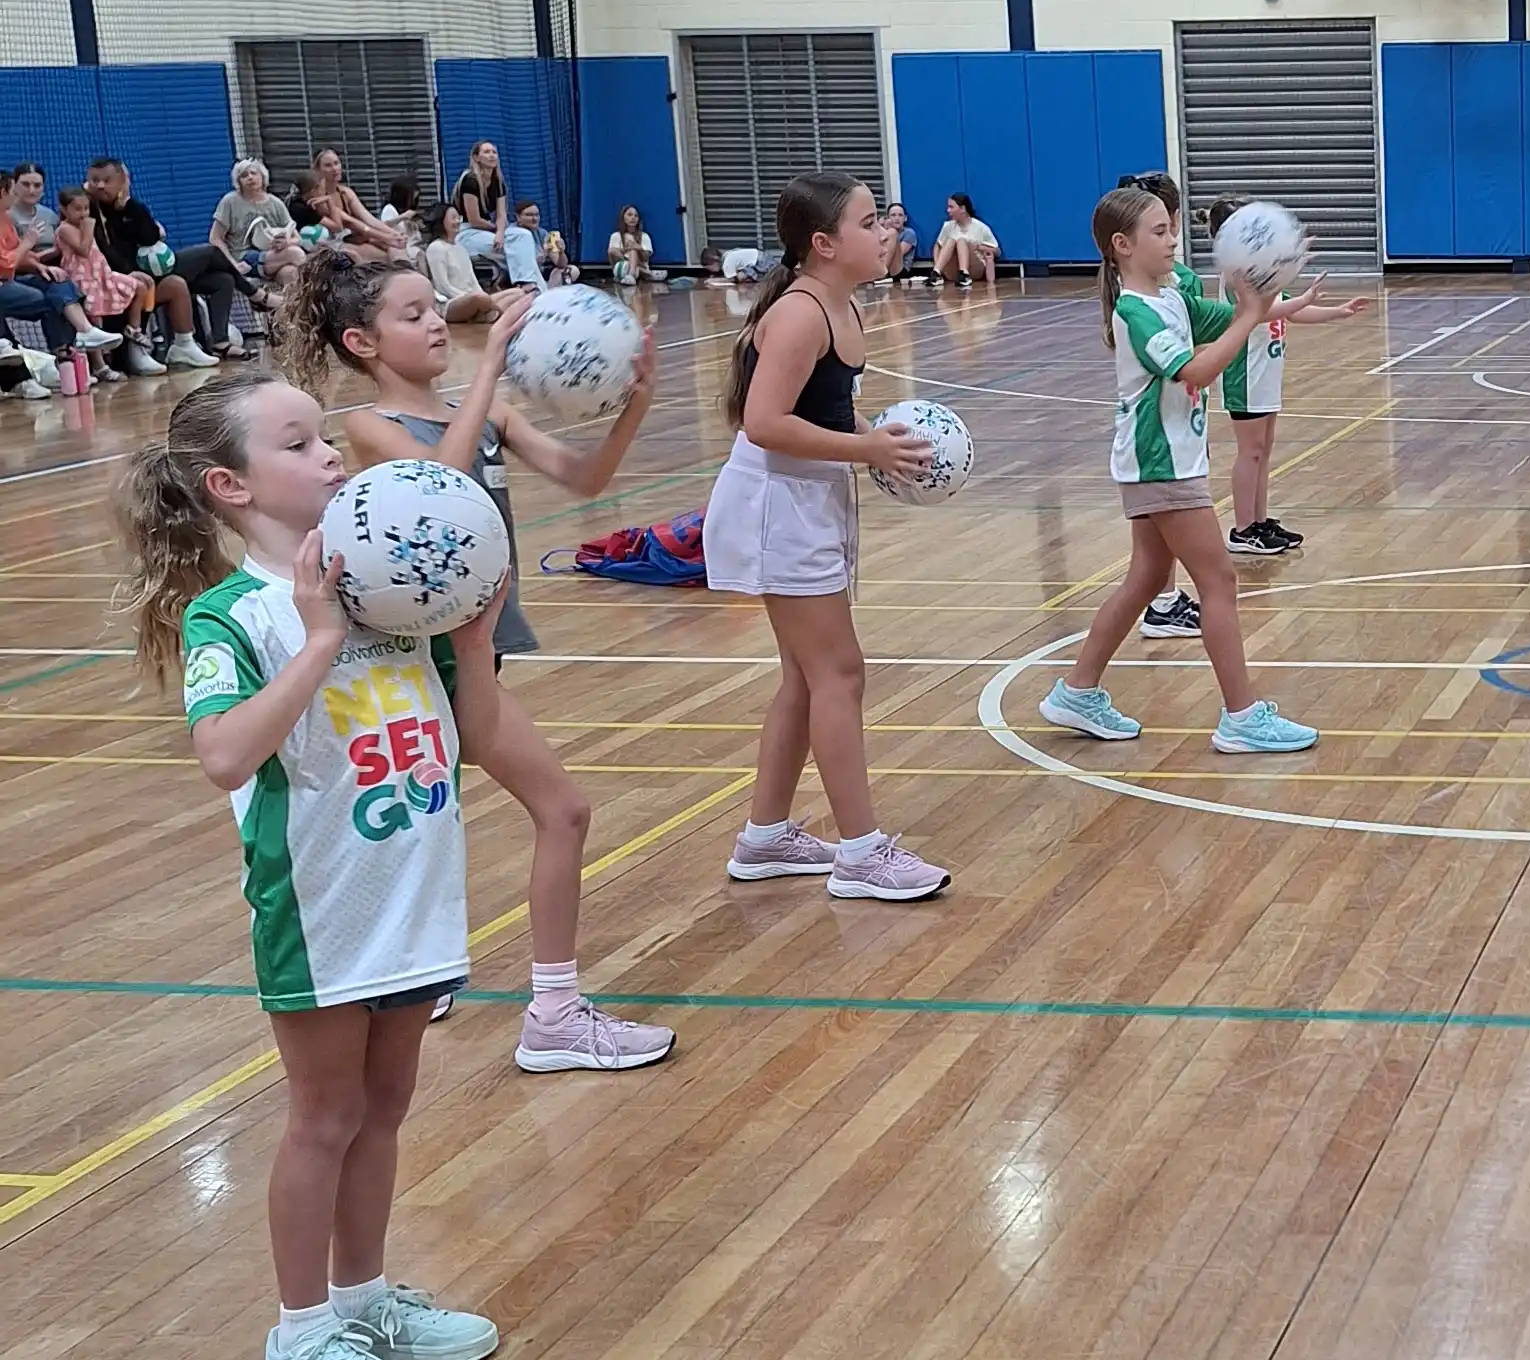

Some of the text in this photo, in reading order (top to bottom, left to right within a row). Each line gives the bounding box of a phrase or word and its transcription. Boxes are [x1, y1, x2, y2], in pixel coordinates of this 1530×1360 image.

[355, 481, 373, 544] HART
[331, 640, 395, 667] oolworths
[323, 664, 433, 736] NET
[349, 717, 449, 787] SET
